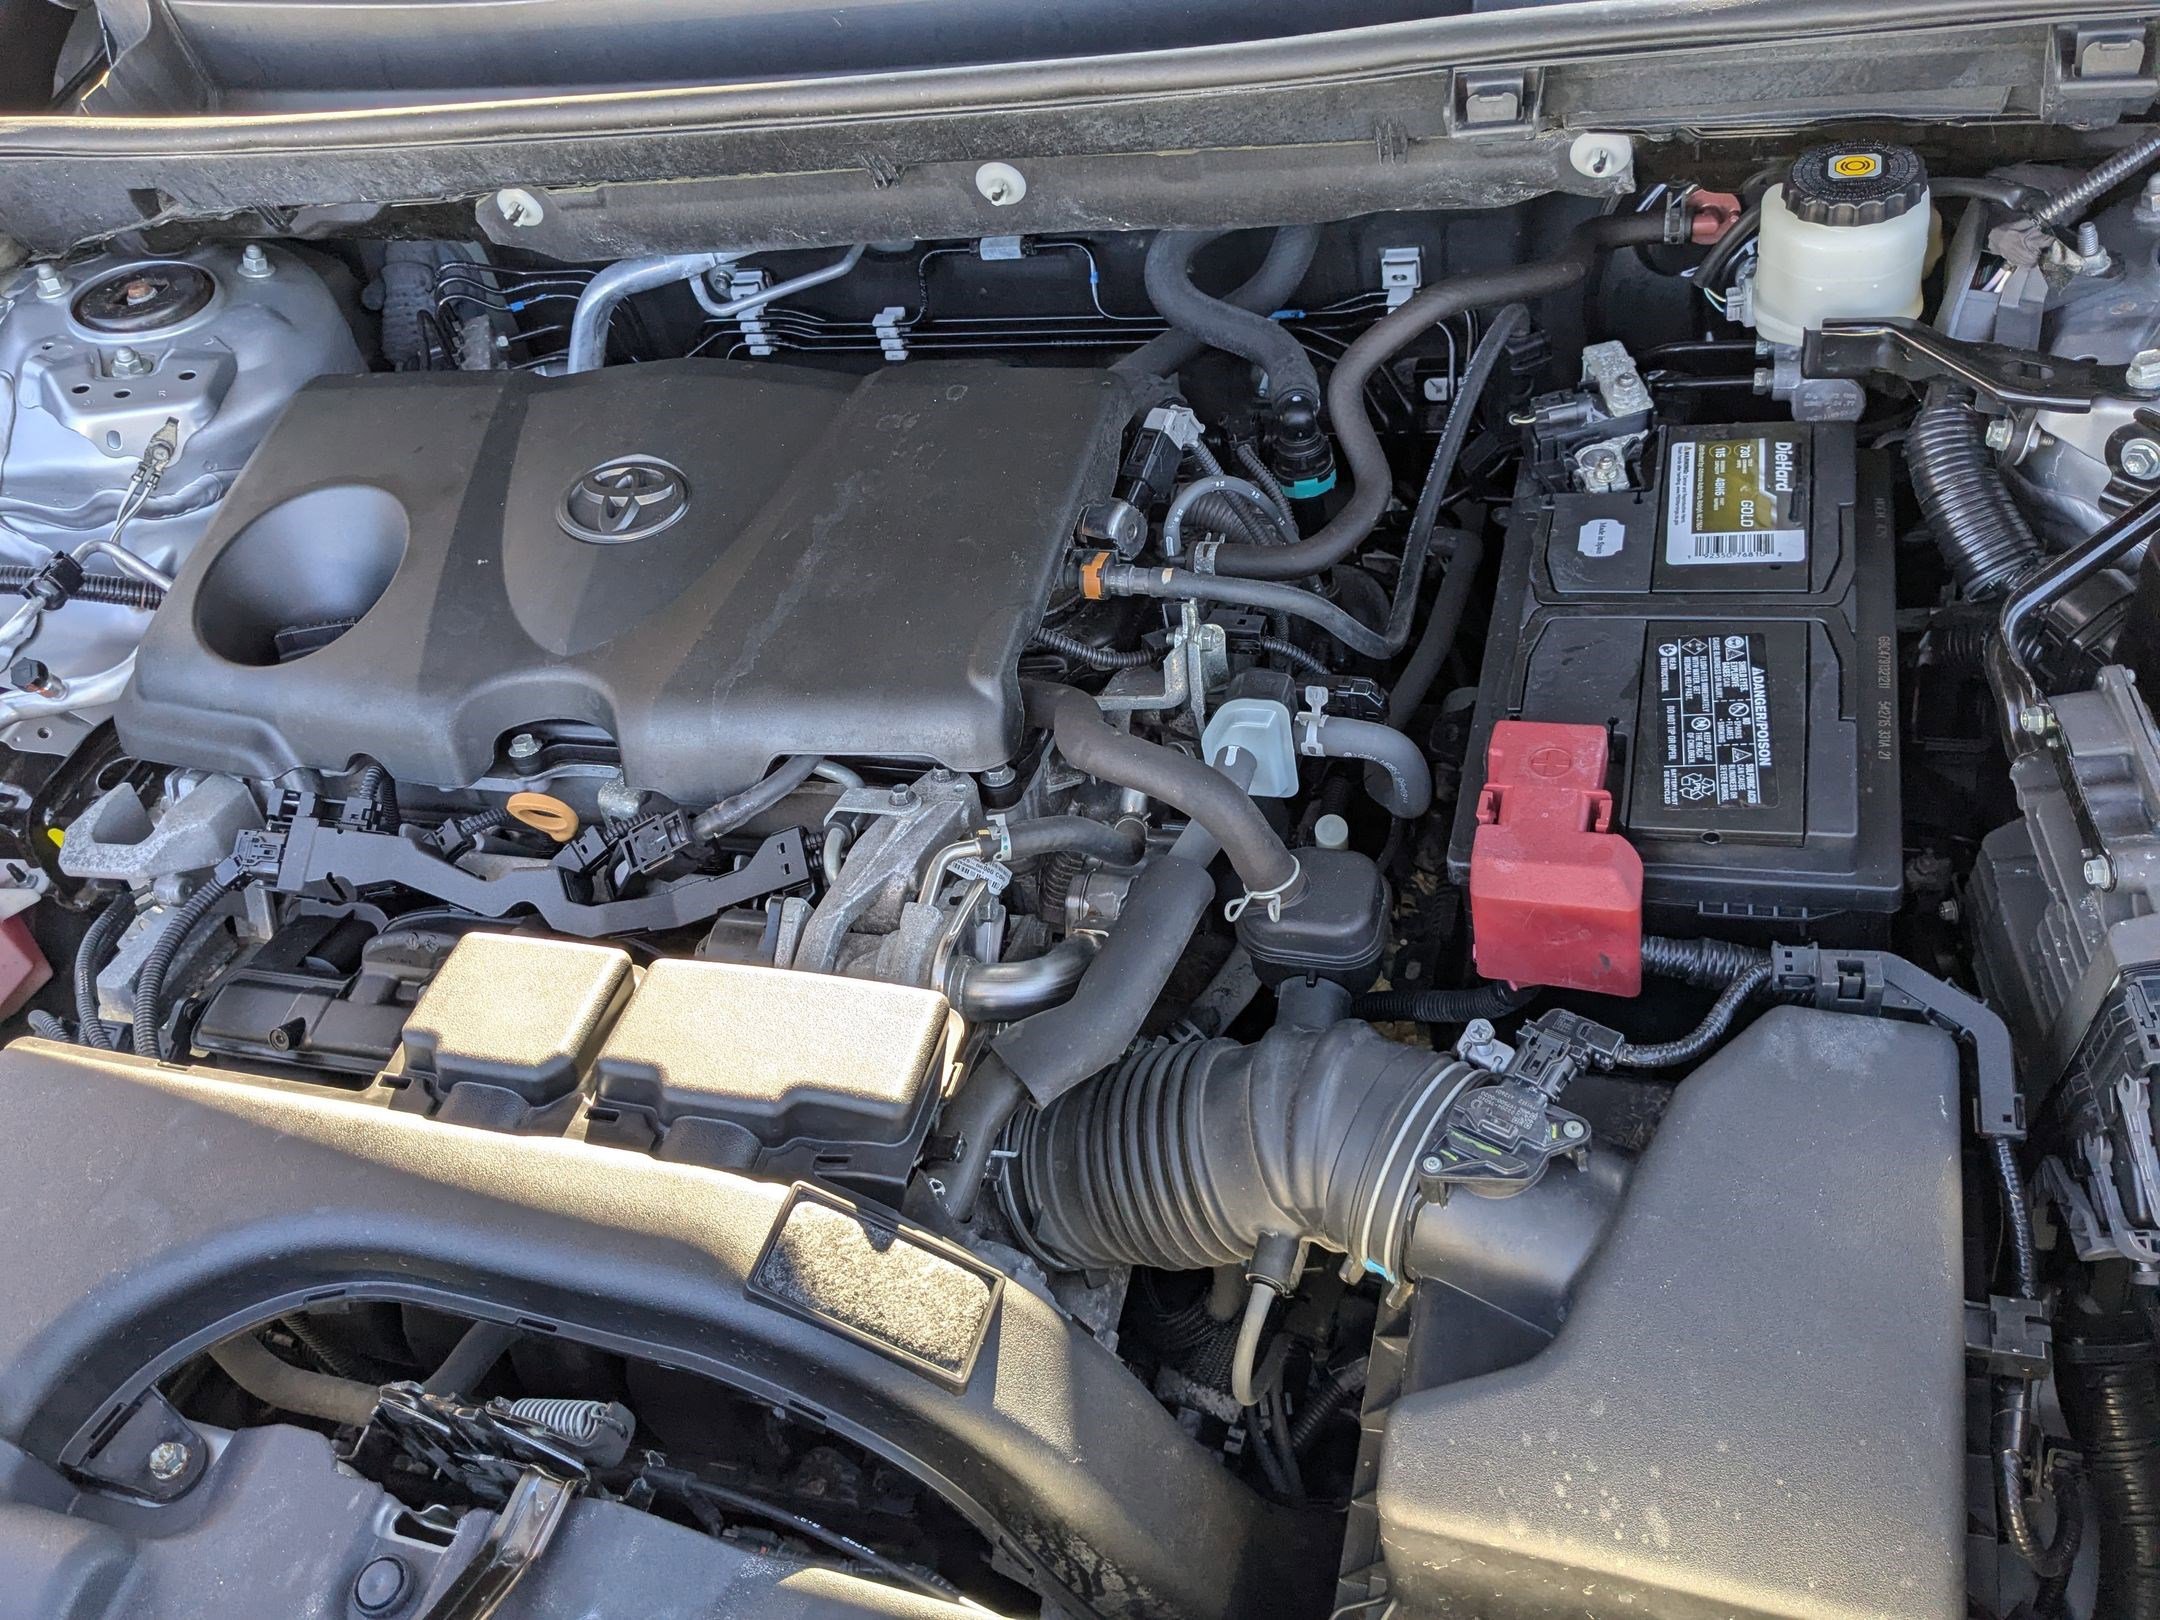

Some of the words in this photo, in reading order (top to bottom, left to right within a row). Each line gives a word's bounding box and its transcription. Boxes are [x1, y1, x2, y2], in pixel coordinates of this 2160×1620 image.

[1715, 448, 1726, 458] 115
[1740, 446, 1750, 458] 730
[1775, 442, 1794, 492] DieHard
[1740, 500, 1754, 527] GOLD
[1599, 522, 1607, 535] Made
[1595, 542, 1604, 554] Spain
[1700, 656, 1708, 670] FLUSH
[1722, 662, 1730, 677] GASES
[1738, 661, 1747, 677] SHIELD
[1700, 671, 1708, 682] EYES
[1730, 661, 1739, 687] EXPLOSIVE
[1684, 676, 1692, 687] HELP
[1740, 678, 1748, 692] EYES.
[1666, 706, 1675, 714] DO
[1667, 714, 1675, 725] NOT
[1752, 675, 1771, 766] DANGER/POISON
[1717, 721, 1726, 743] SMOKING
[1725, 720, 1734, 739] FLAMES
[1734, 720, 1742, 739] SPARKS
[1704, 732, 1712, 743] KEEP
[1704, 744, 1712, 754] OUT
[1878, 750, 1892, 760] 21
[1720, 764, 1728, 783] SEVERE
[1728, 764, 1737, 791] BLINDNESS
[1746, 764, 1755, 790] SULFURIC
[1737, 775, 1746, 790] CAUSE
[1748, 790, 1756, 803] ACID
